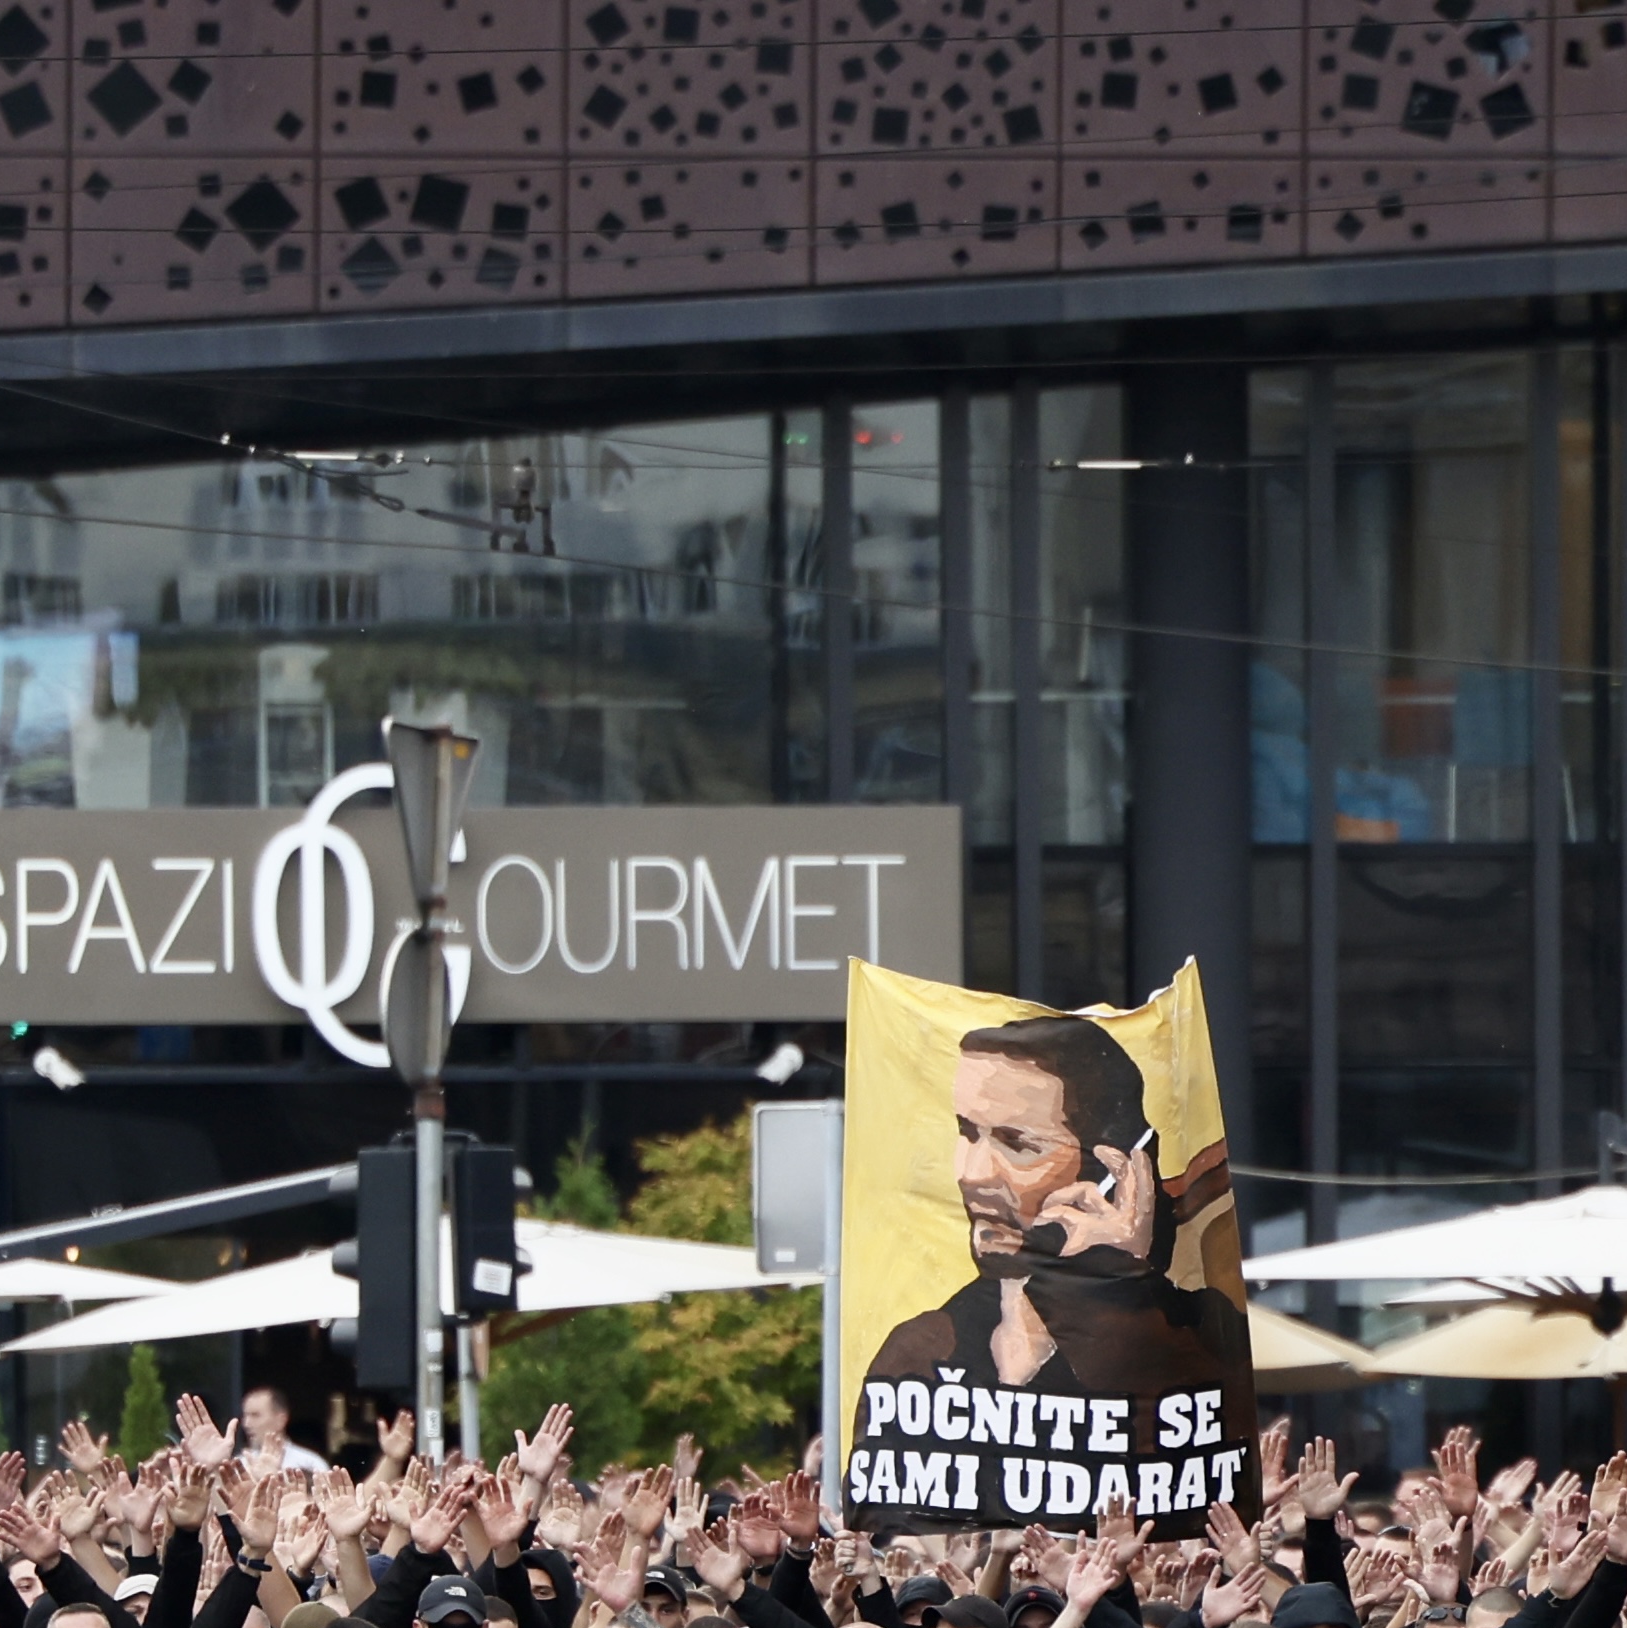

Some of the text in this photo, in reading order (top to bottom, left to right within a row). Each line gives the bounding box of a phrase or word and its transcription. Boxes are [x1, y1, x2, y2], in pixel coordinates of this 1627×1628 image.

[866, 1367, 1222, 1453] POČNITE SE
[850, 1447, 1247, 1515] SAMI UDARAT
